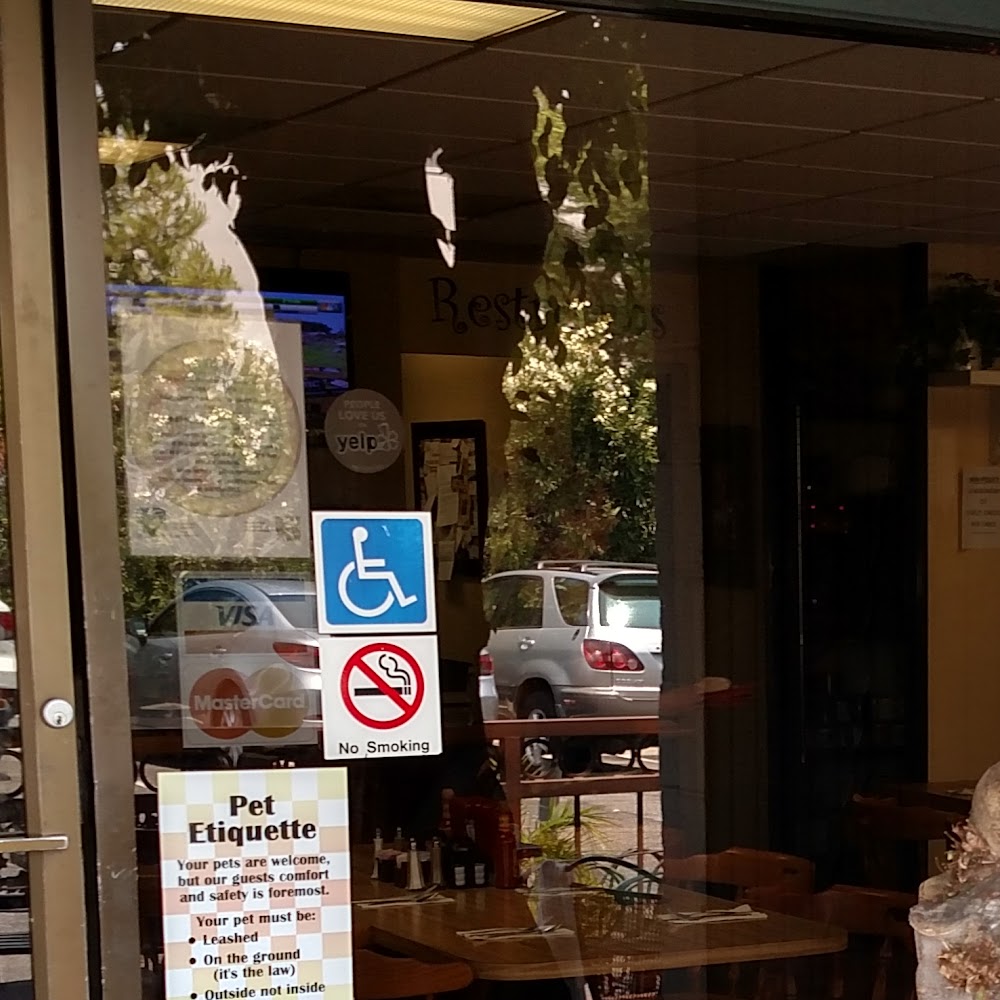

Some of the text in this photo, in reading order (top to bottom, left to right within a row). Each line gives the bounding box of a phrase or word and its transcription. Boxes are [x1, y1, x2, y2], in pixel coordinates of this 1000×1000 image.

[338, 410, 368, 420] LOVE
[337, 432, 377, 453] yelp
[215, 605, 274, 626] VISA
[194, 694, 305, 712] MasterCard
[339, 740, 430, 754] No Smoking
[229, 795, 276, 817] Pet
[188, 819, 317, 847] Etiquette
[177, 854, 331, 872] Your pets are welcome,
[178, 869, 330, 887] but our guests comfort
[179, 884, 330, 903] and safety is foremost.
[196, 910, 316, 927] Your pet must be:
[203, 931, 259, 946] Leashed
[203, 949, 301, 966] On the ground
[213, 964, 296, 982] (it's the law)
[204, 981, 326, 1000] Outside not inside
